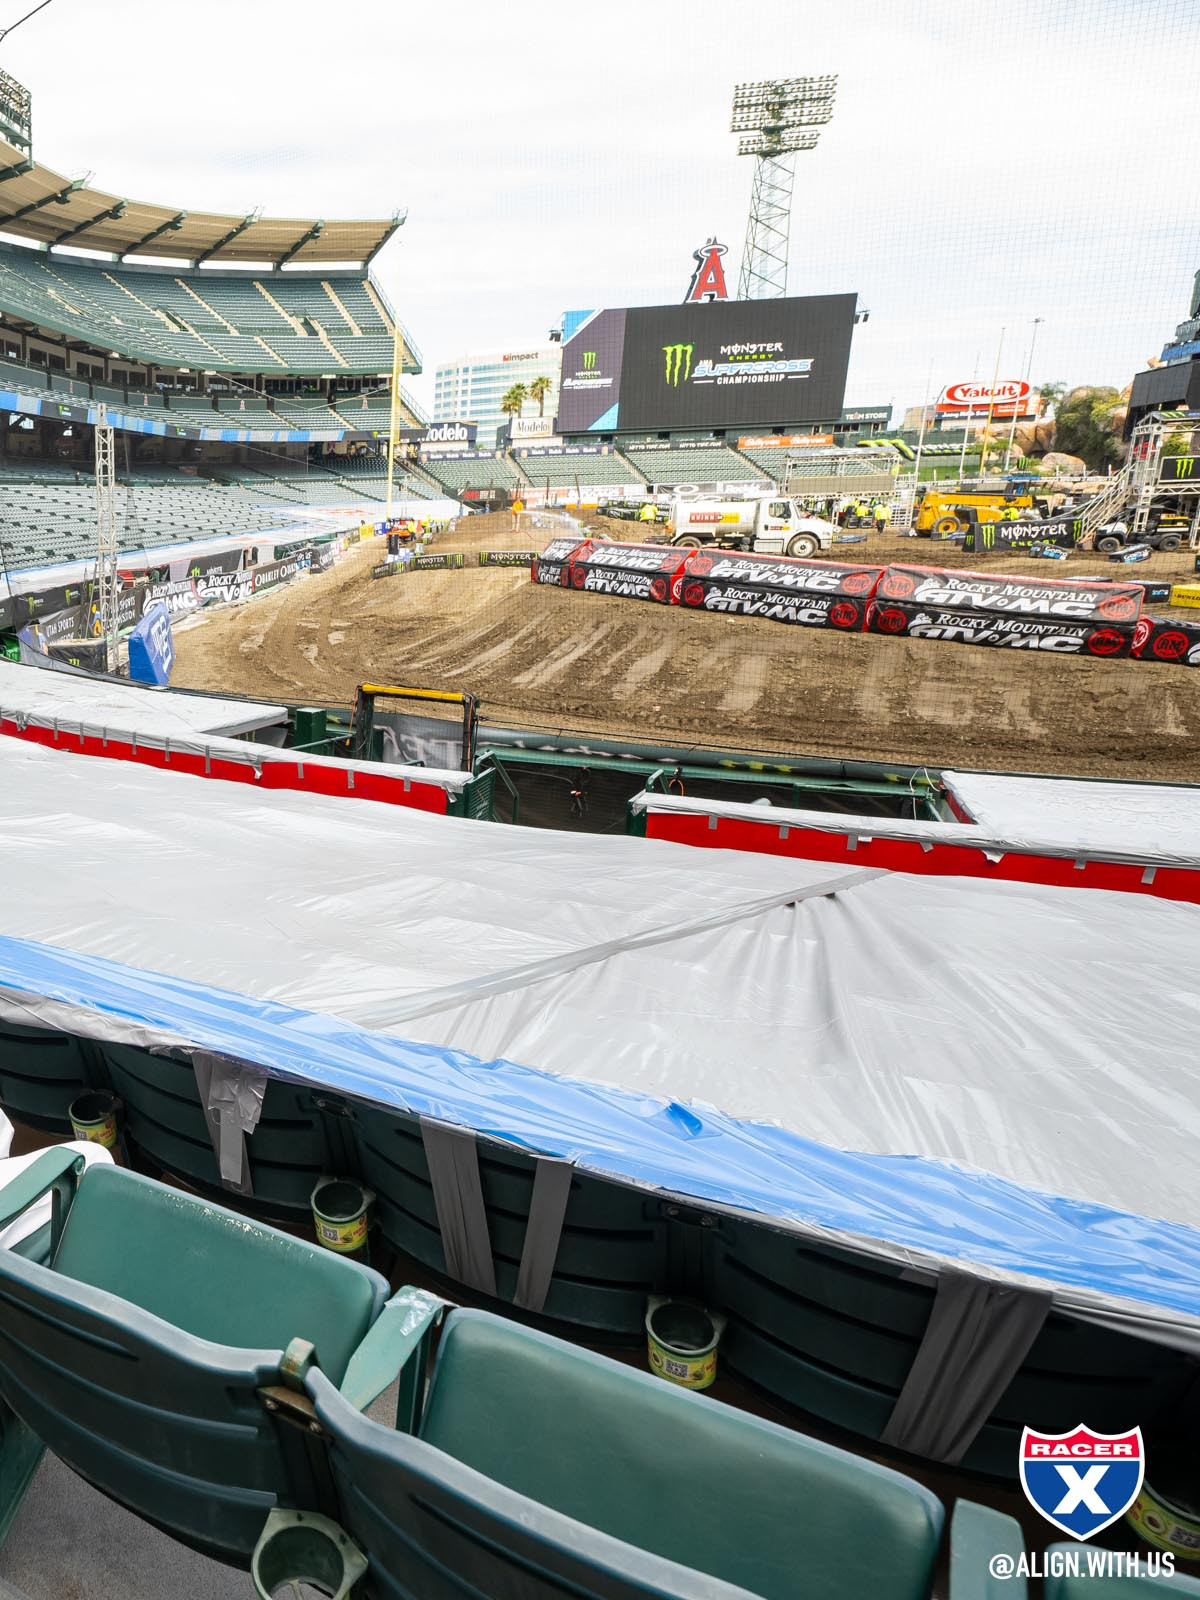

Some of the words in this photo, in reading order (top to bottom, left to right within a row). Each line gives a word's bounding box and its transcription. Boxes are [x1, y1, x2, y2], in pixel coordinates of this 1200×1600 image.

[720, 342, 784, 356] MONSTER
[509, 352, 539, 362] impact
[728, 353, 774, 361] ENERGY
[691, 358, 815, 378] SUPERCROSS
[716, 373, 786, 385] CHAMPIONSHIP
[960, 385, 1017, 398] Yakult
[865, 412, 888, 420] STORE
[426, 422, 468, 442] odelo
[516, 420, 549, 434] Modelo
[1000, 523, 1068, 540] MONSTER
[417, 557, 445, 565] MONSTER
[491, 552, 531, 561] MONSTER
[733, 559, 771, 572] ROCKY
[773, 564, 845, 578] MOUNTAIN
[945, 578, 1000, 594] ROCKY
[998, 584, 1098, 603] MOUNTAIN
[723, 587, 762, 601] ROCKY
[763, 592, 832, 610] MOUNTAIN
[58, 616, 75, 632] SPORTS
[936, 613, 992, 629] ROCKY
[990, 619, 1089, 638] MOUNTAIN
